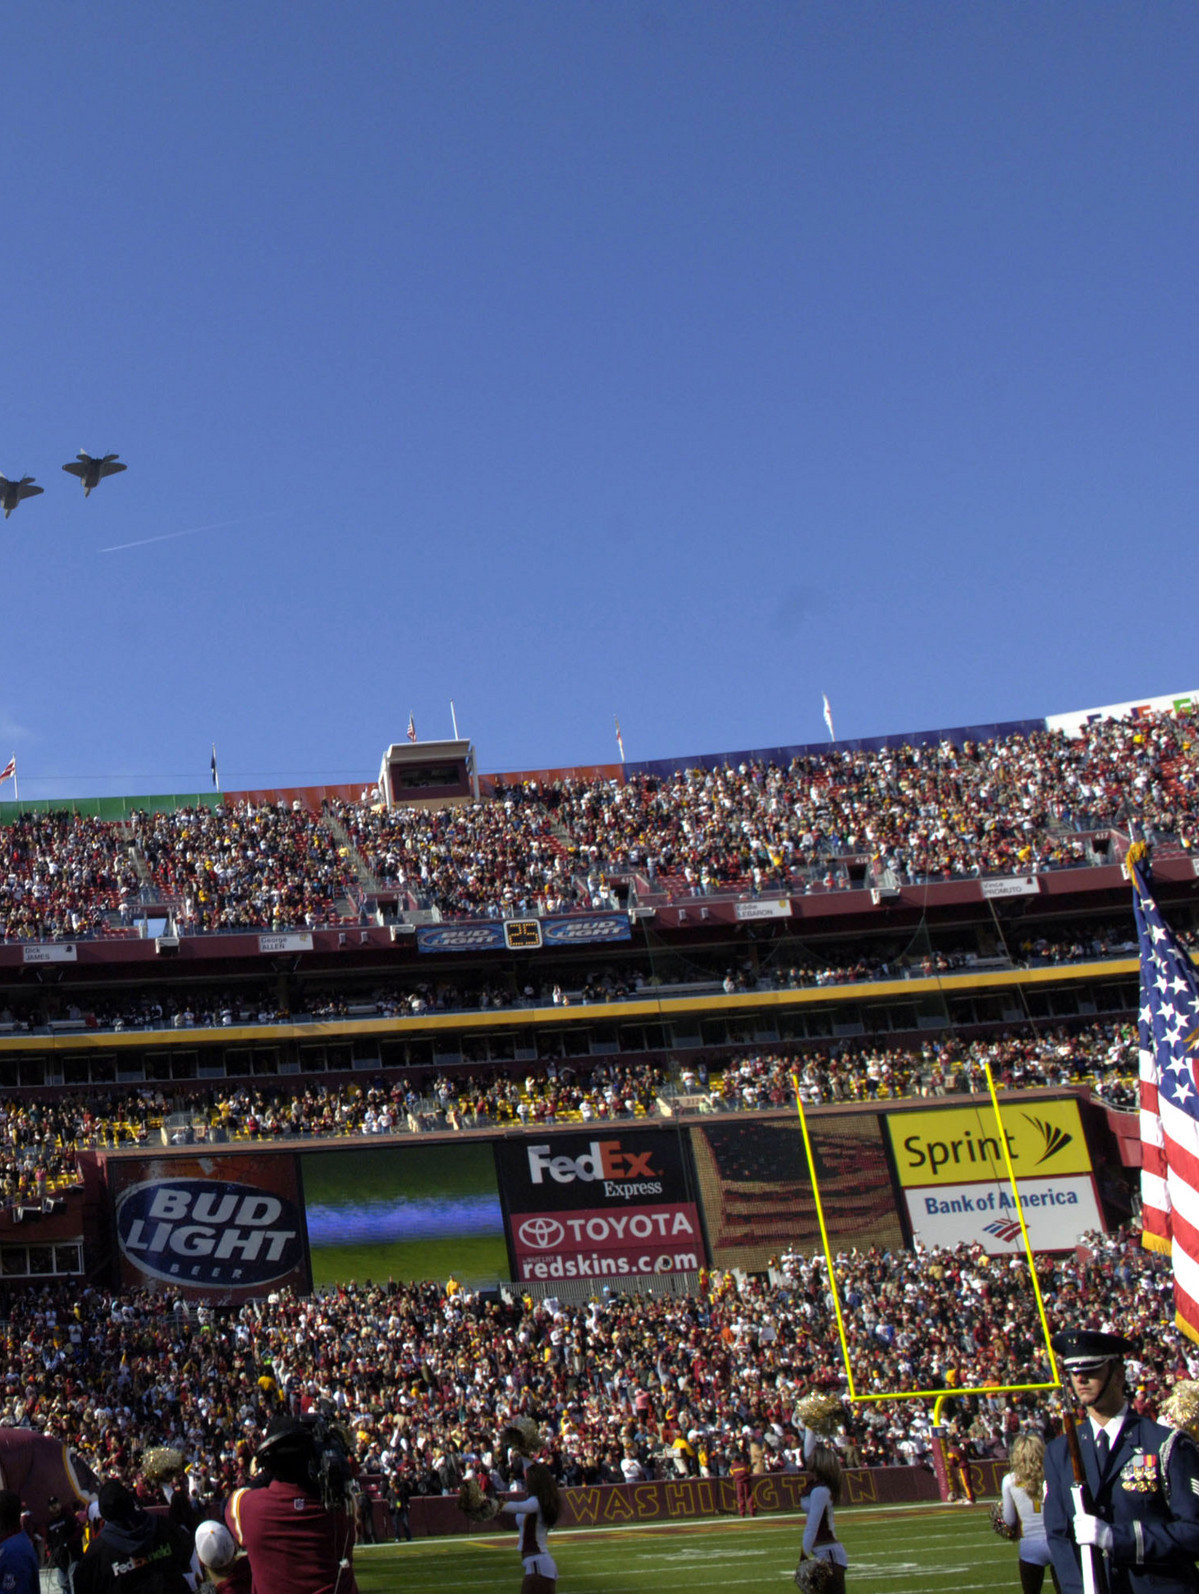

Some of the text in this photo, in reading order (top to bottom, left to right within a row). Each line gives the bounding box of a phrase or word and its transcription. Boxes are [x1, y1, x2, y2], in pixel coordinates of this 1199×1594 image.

[441, 929, 490, 938] BUD
[508, 922, 539, 947] 25
[555, 926, 625, 938] LIGHT
[566, 920, 617, 931] BUD
[434, 935, 499, 945] LIGHT
[527, 1140, 657, 1184] FedEx
[904, 1129, 1019, 1175] Sprint
[603, 1180, 663, 1200] Express
[924, 1188, 1079, 1215] Bank of America
[149, 1187, 283, 1227] BUD
[566, 1211, 694, 1242] TOYOTA
[125, 1219, 297, 1262] LIGHT
[169, 1263, 243, 1280] BEER
[565, 1470, 878, 1522] WASHINGTN
